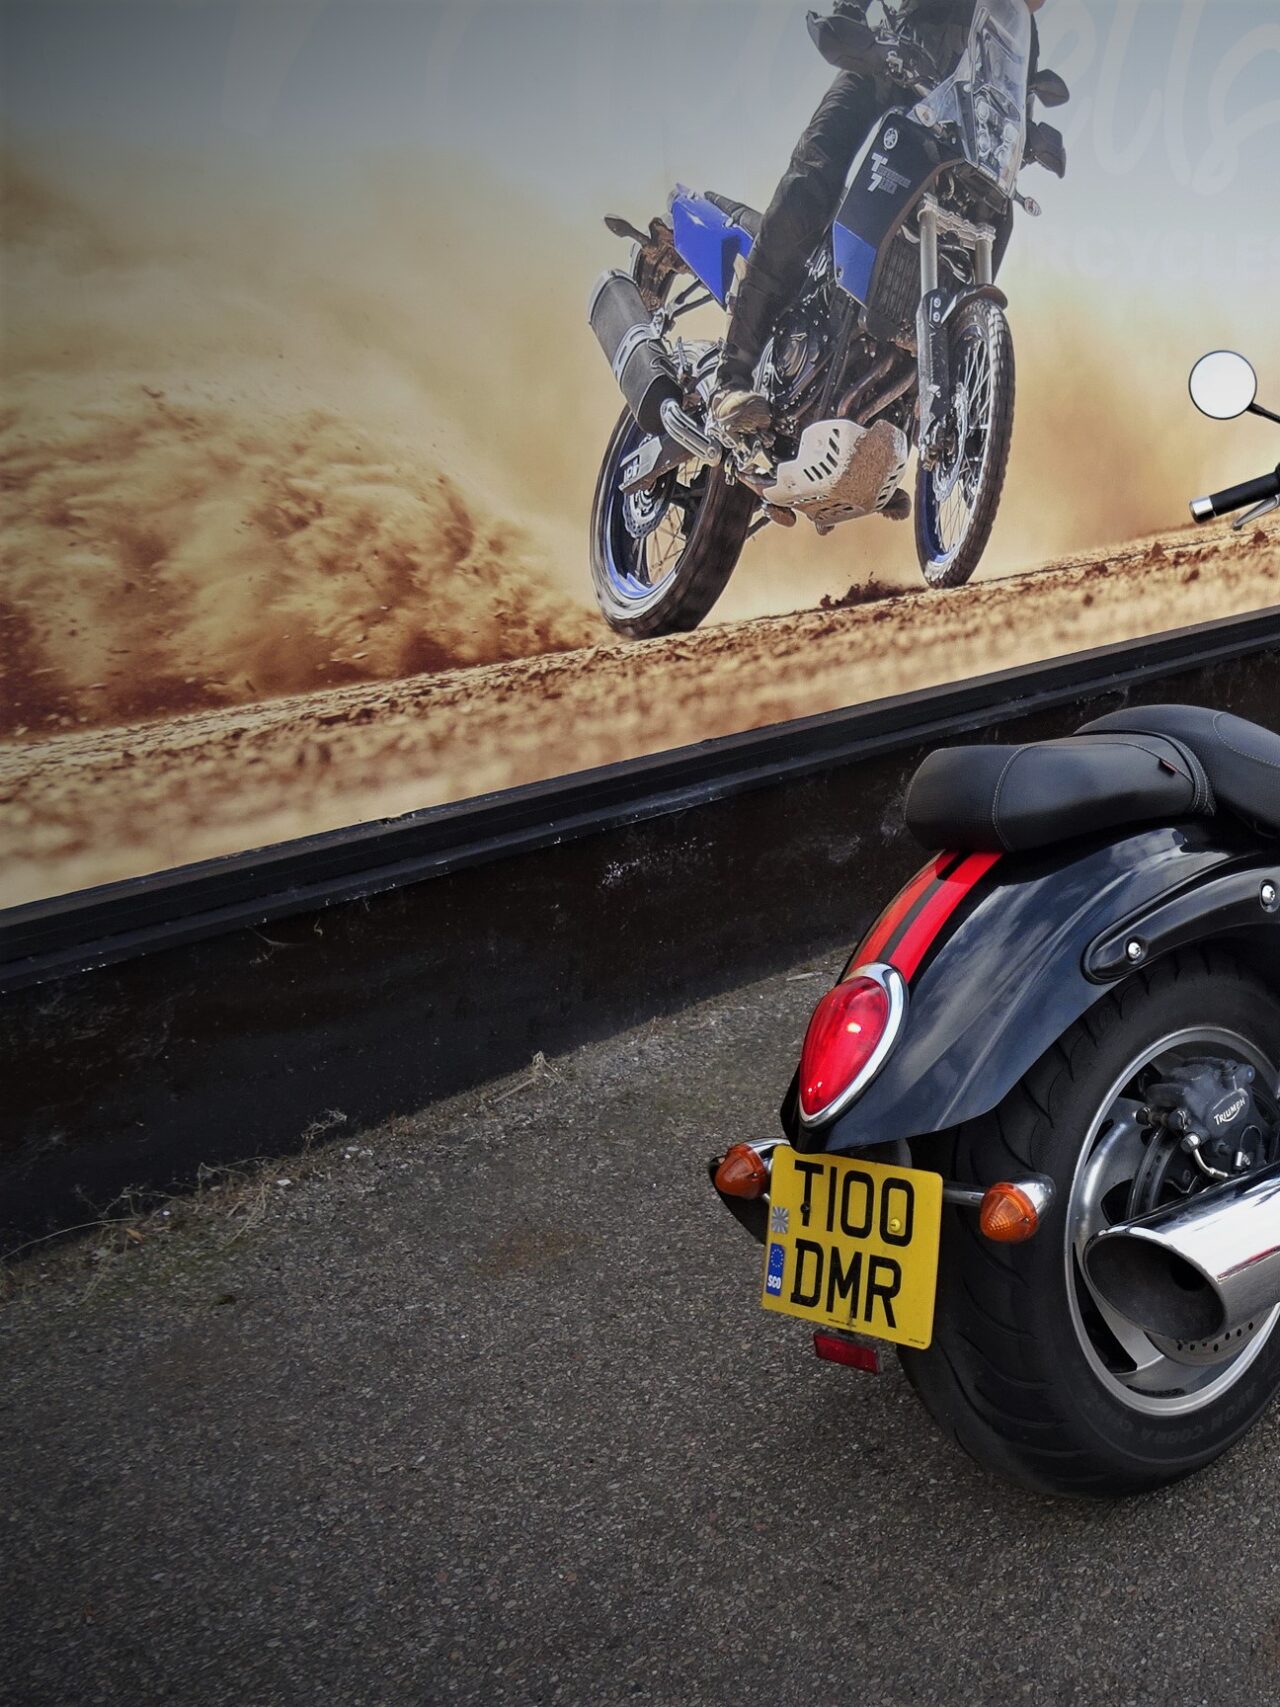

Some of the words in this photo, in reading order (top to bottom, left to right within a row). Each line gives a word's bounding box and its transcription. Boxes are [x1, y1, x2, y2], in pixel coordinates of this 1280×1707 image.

[1213, 1096, 1246, 1126] TRIUMPH
[794, 1159, 915, 1248] T100
[790, 1238, 903, 1330] DMR
